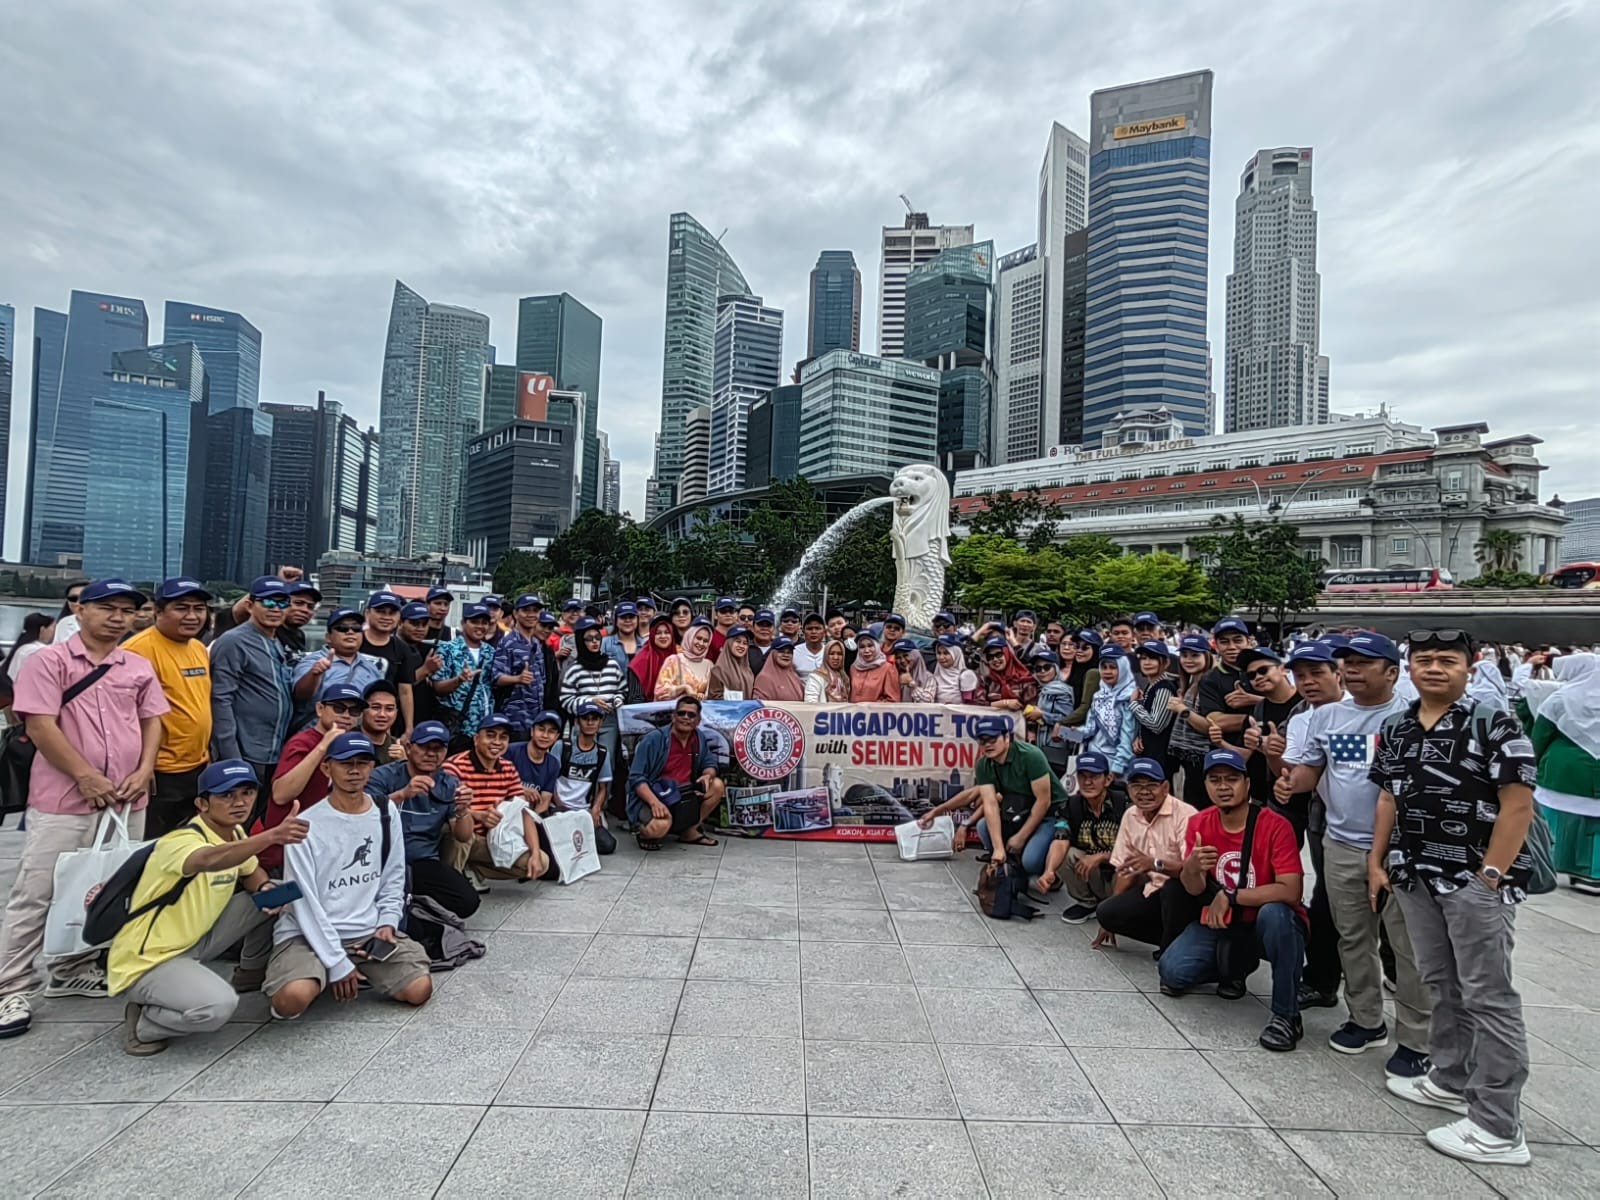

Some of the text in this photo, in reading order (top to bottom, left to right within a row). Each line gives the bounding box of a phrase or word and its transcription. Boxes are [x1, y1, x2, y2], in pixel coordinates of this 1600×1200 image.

[1129, 119, 1178, 135] Maybank
[110, 304, 135, 316] DBS
[203, 315, 225, 323] HSBC
[1075, 439, 1196, 461] THE FULLERTON HOTEL
[736, 709, 802, 742] SEMEN TONASA
[813, 712, 943, 737] SINGAPORE
[815, 739, 848, 754] with
[851, 740, 926, 767] SEMEN
[740, 756, 799, 778] INDONESIA
